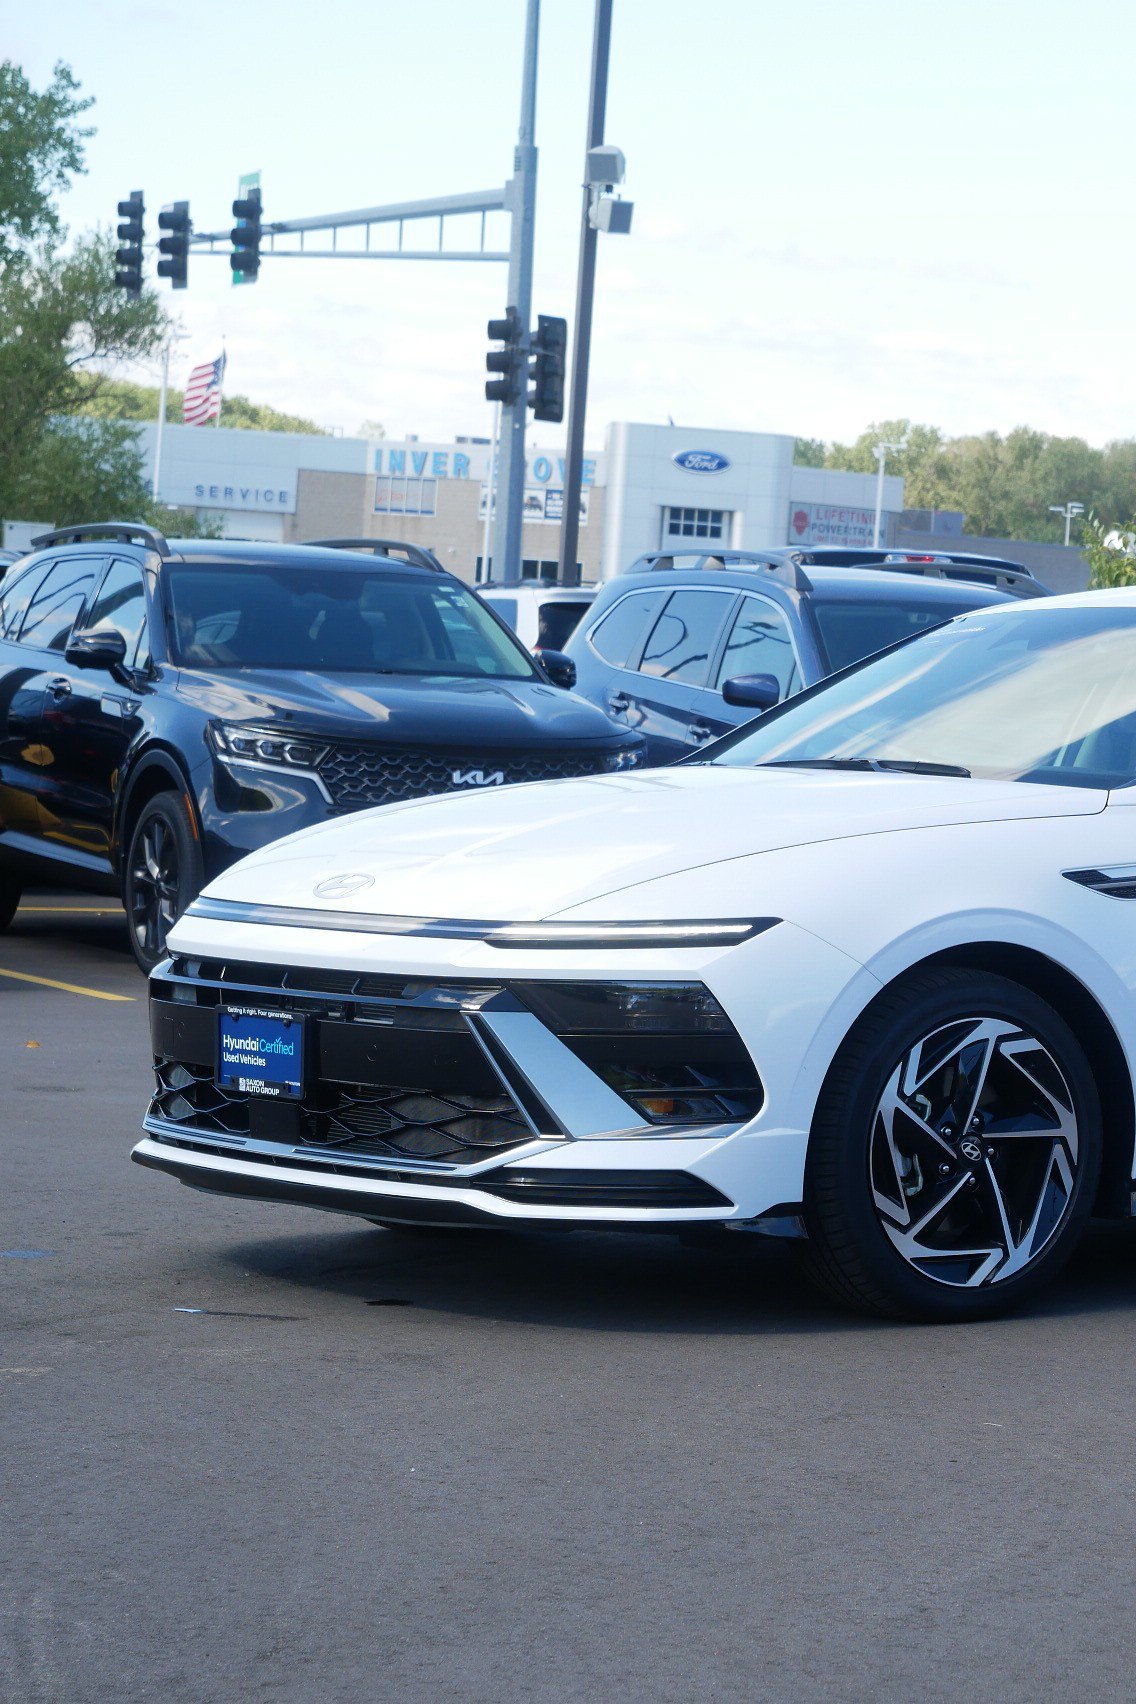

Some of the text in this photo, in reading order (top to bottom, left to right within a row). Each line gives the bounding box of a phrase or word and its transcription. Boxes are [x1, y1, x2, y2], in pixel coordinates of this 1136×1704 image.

[375, 448, 470, 478] INVER
[685, 454, 719, 469] Ford
[195, 484, 288, 503] SERVICE
[815, 508, 880, 526] LIFETIM
[811, 522, 885, 538] POWERTRAN
[453, 769, 504, 785] KIA
[227, 1006, 242, 1015] Getting
[223, 1034, 259, 1052] Hyundai
[223, 1052, 266, 1067] Used Vehicles
[245, 1078, 265, 1087] SAXON
[260, 1087, 280, 1096] GROUP
